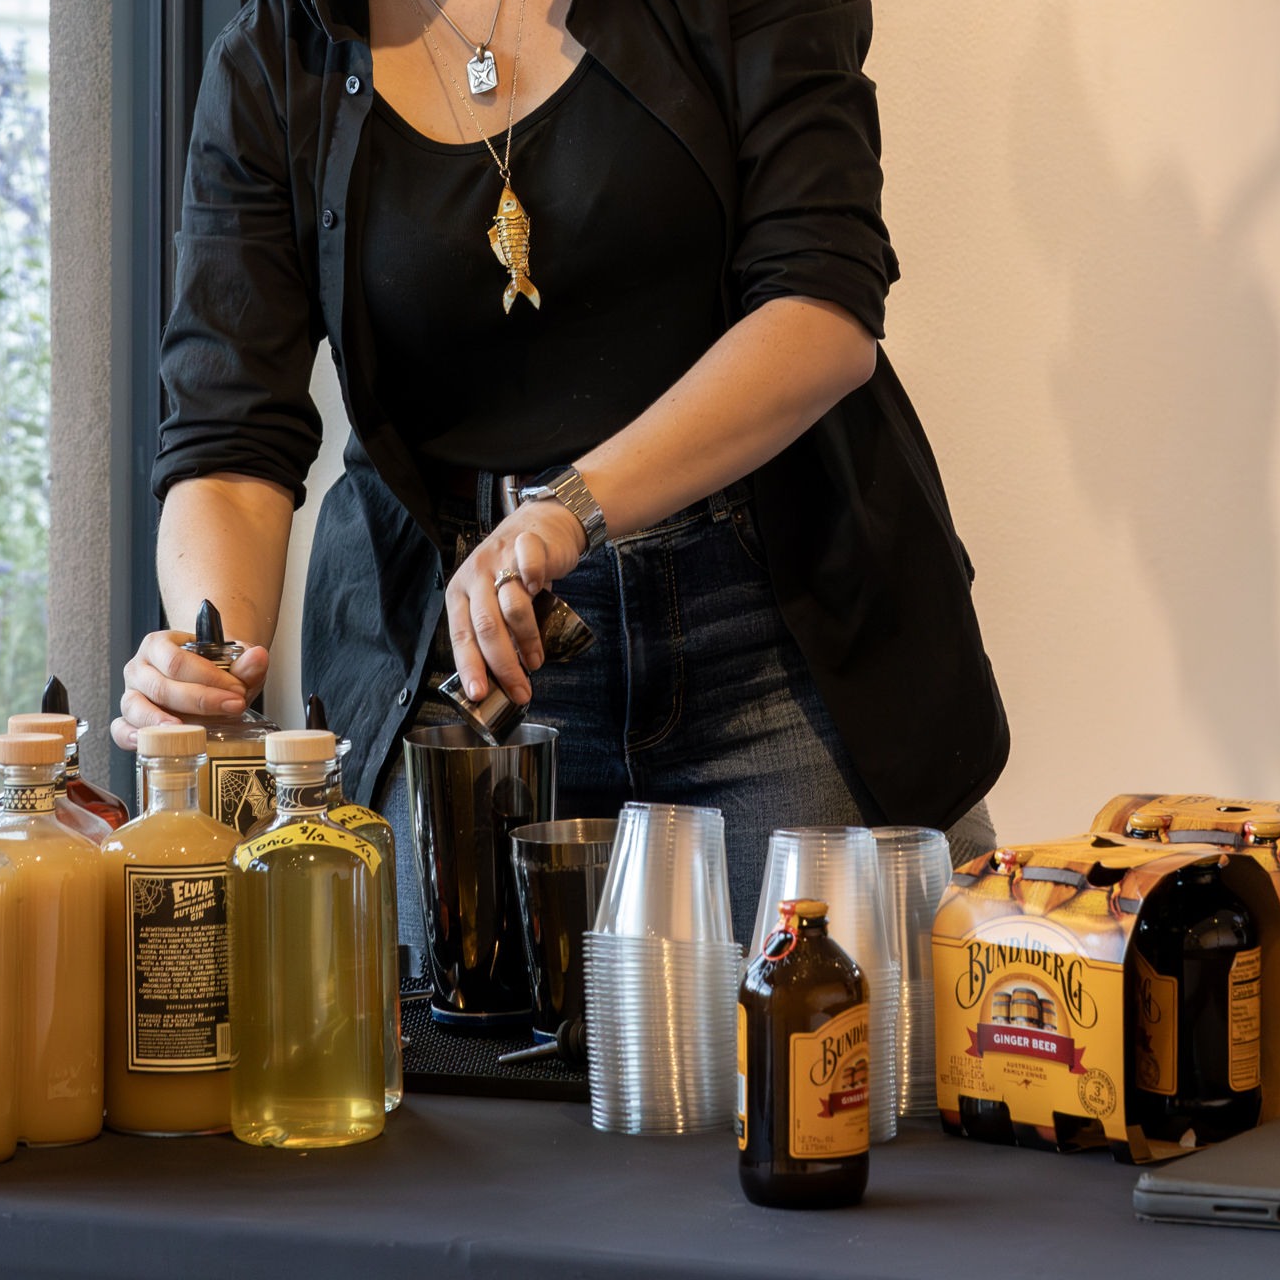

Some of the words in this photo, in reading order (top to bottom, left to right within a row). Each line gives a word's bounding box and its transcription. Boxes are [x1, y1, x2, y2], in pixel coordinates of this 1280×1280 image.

[242, 835, 294, 857] Tonic
[172, 879, 214, 904] ELVIRA
[173, 898, 216, 919] AUTUMNAL
[190, 910, 205, 922] GIN
[956, 932, 1098, 1029] BUNDABERG
[993, 1033, 1030, 1048] GINGER
[1032, 1039, 1057, 1054] BEER
